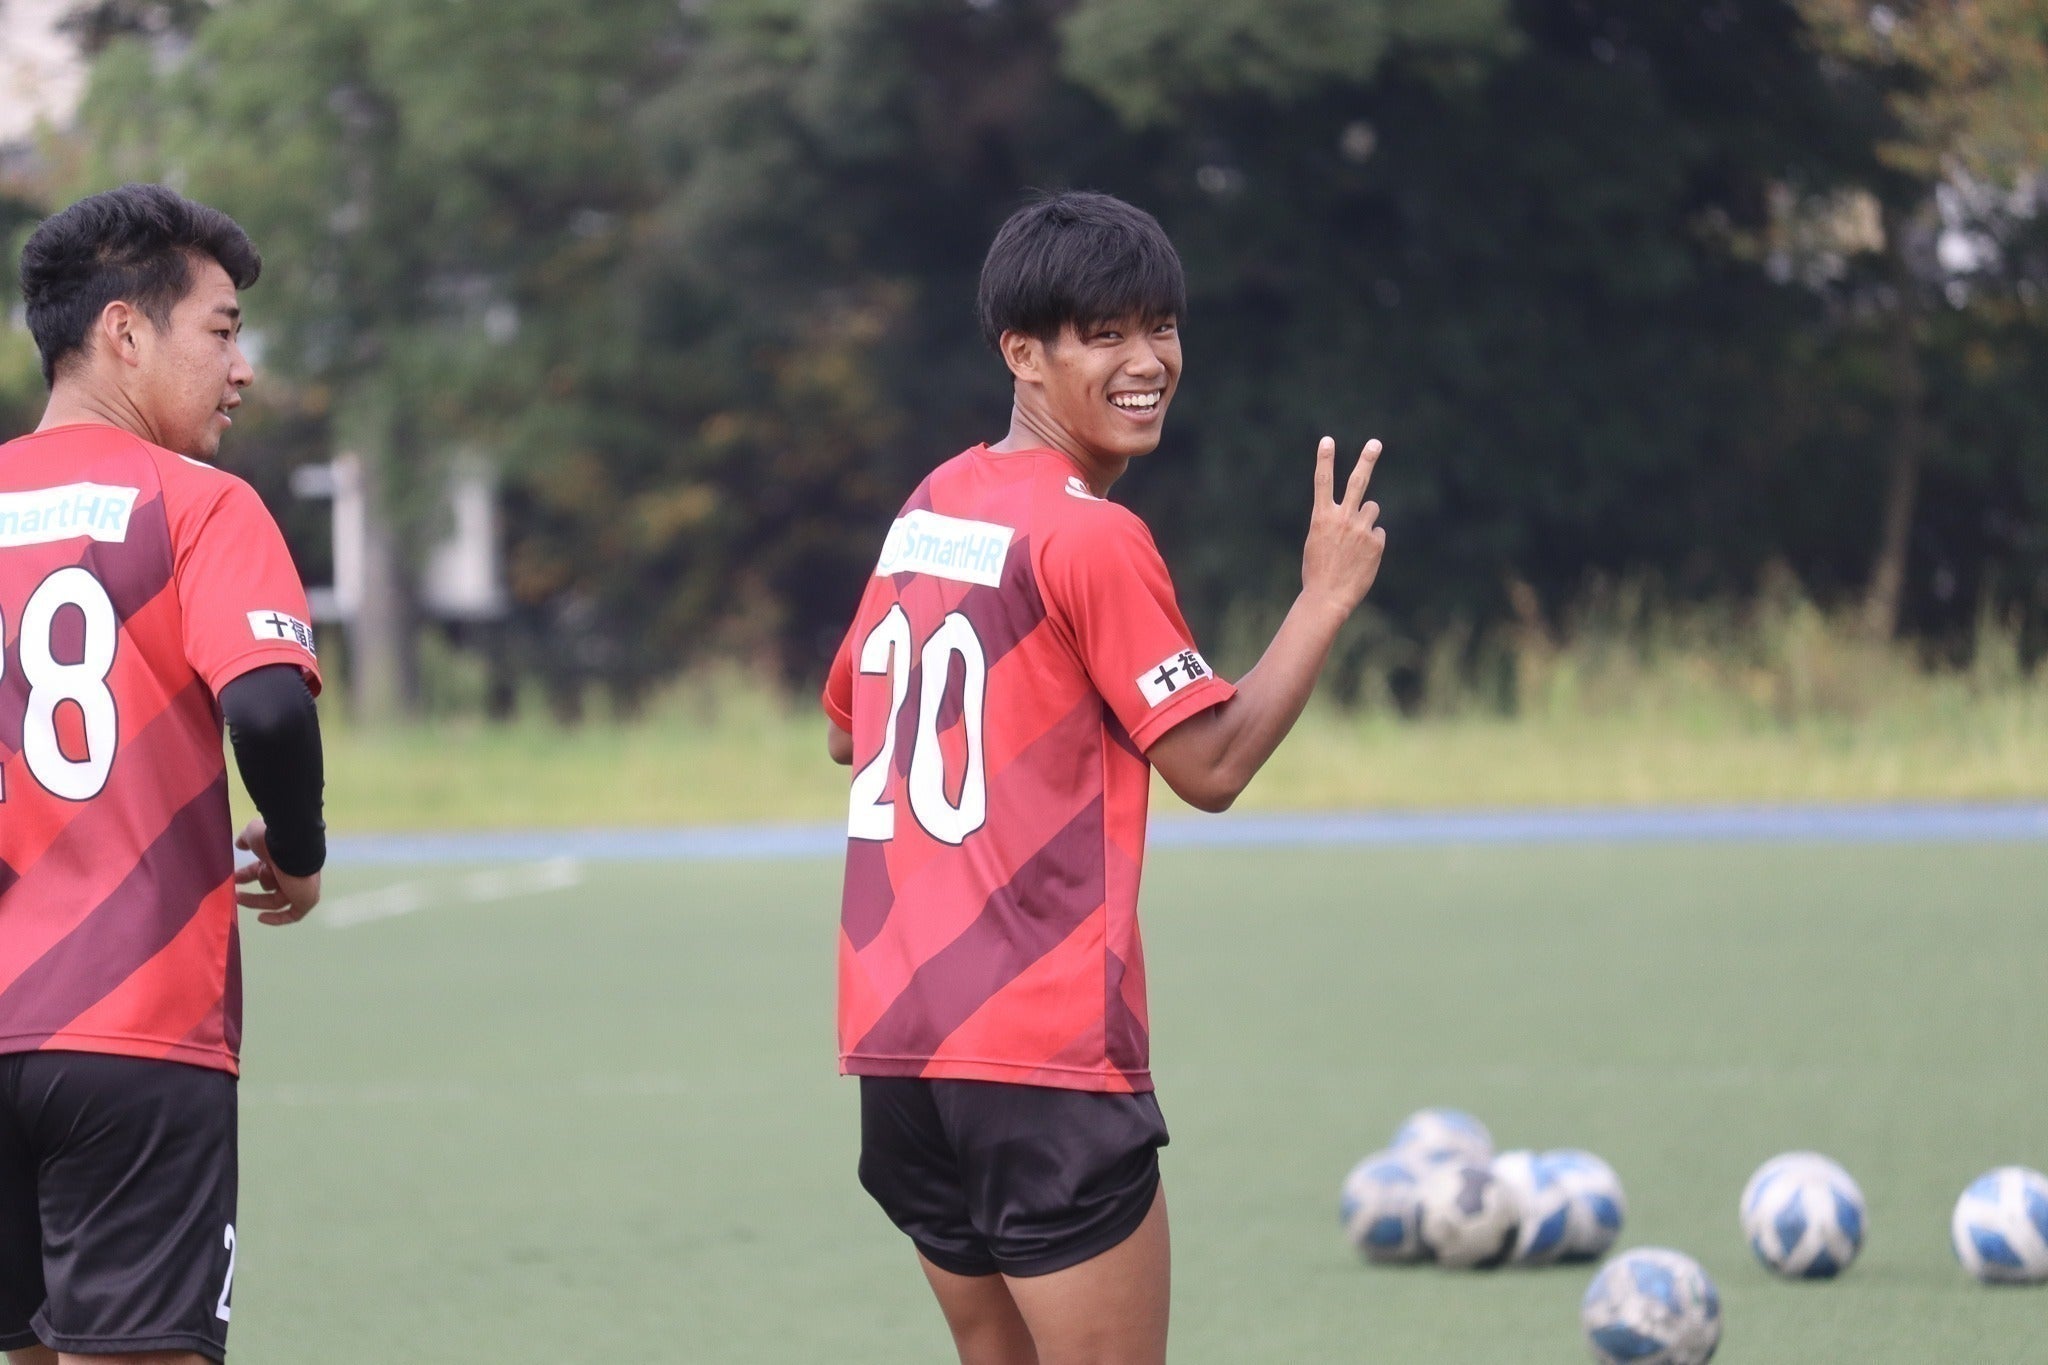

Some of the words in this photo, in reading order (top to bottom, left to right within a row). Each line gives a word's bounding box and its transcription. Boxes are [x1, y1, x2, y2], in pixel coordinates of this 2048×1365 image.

[902, 521, 1004, 574] SmartHR
[0, 565, 119, 802] 8
[847, 602, 988, 846] 20
